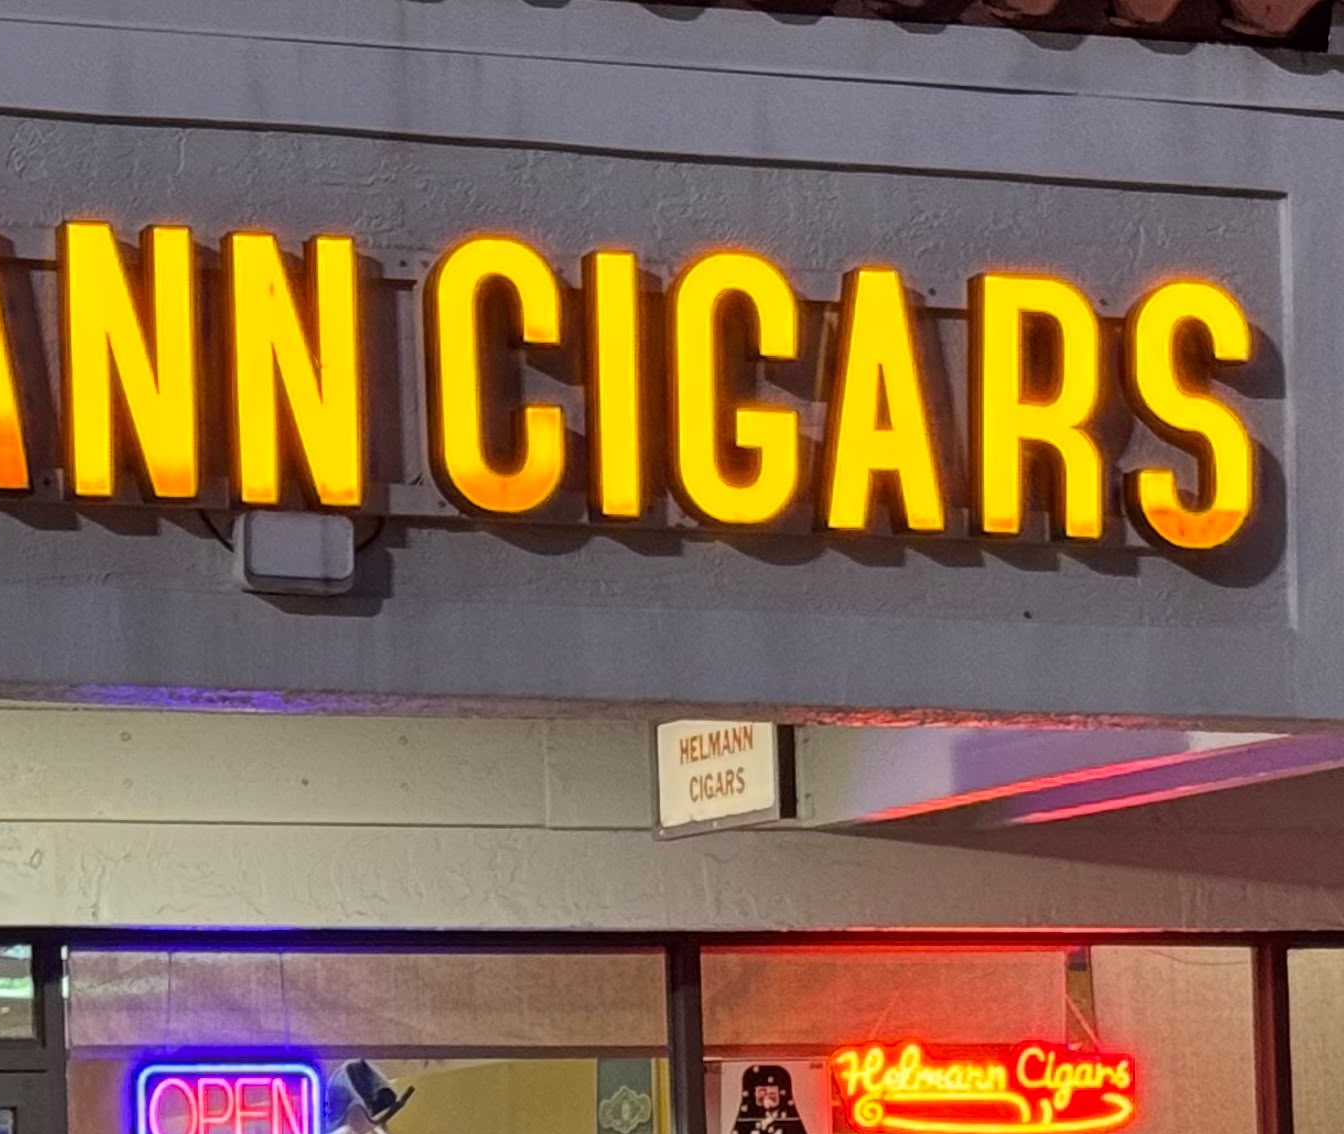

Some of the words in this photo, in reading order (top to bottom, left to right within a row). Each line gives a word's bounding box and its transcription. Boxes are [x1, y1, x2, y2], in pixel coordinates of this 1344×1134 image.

[430, 236, 1254, 550] CIGARS
[679, 724, 754, 766] HELMANN
[689, 767, 746, 803] CIGARS
[837, 1044, 1008, 1097] Helmann
[1017, 1045, 1132, 1111] Cigars
